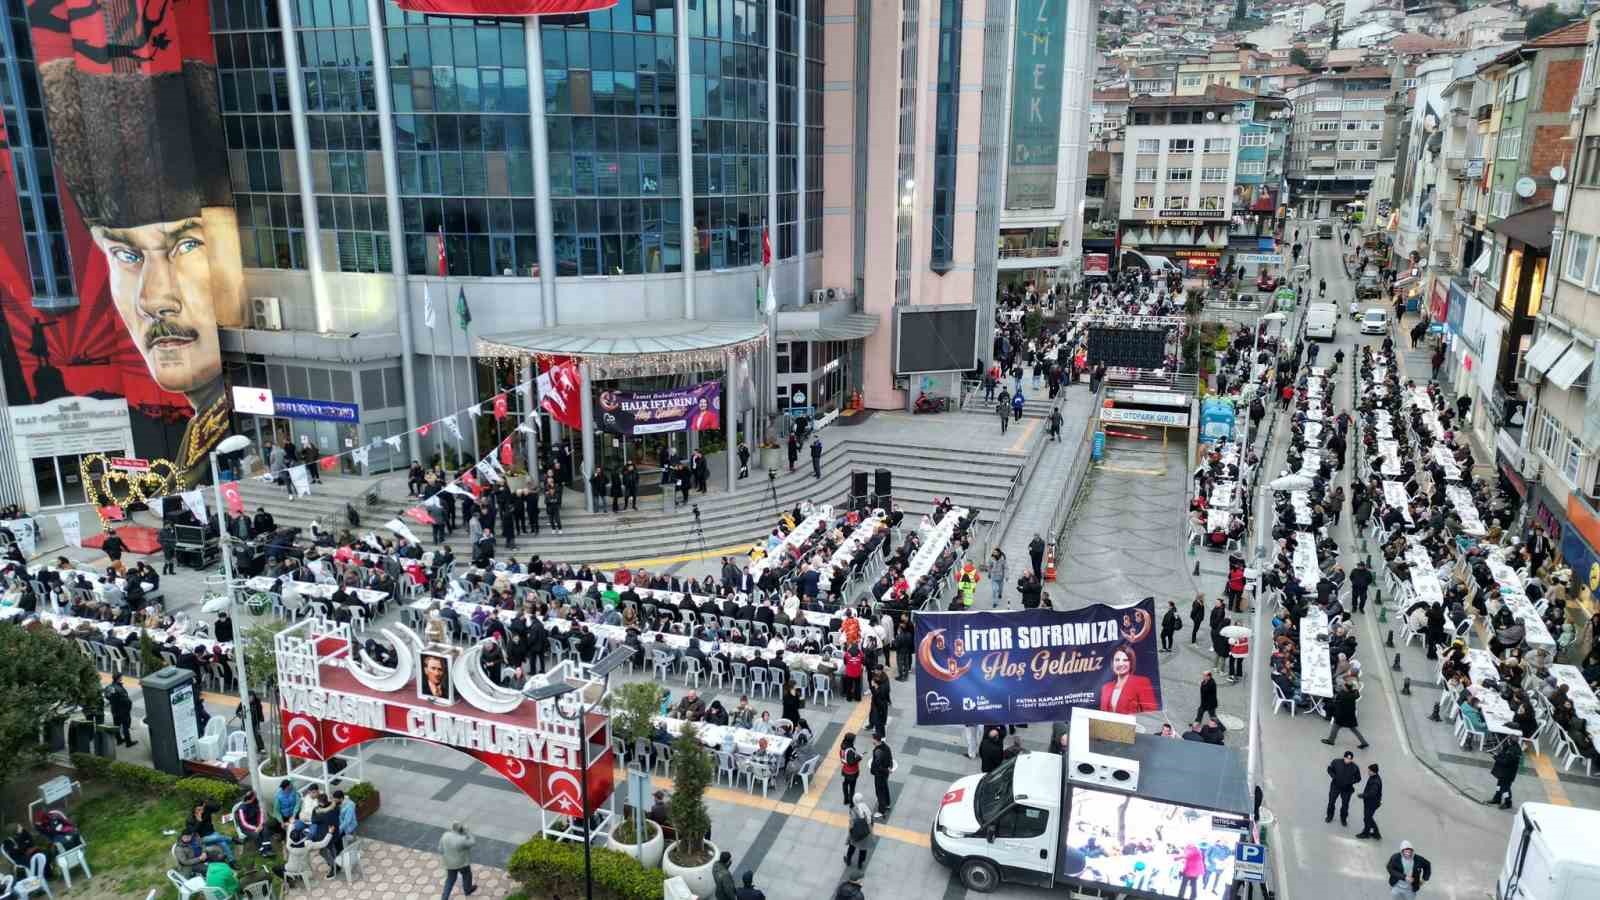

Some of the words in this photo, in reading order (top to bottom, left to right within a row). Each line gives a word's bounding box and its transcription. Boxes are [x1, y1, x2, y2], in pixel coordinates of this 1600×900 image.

[621, 399, 649, 411] HALK
[1122, 411, 1155, 420] OTOPARK
[964, 624, 1012, 652] İFTAR
[1018, 619, 1119, 650] SOFRAMIZA
[981, 652, 1026, 681] Hoş
[1030, 649, 1105, 681] Geldiniz
[407, 707, 580, 770] CUMHURİYET
[1242, 845, 1260, 861] P
